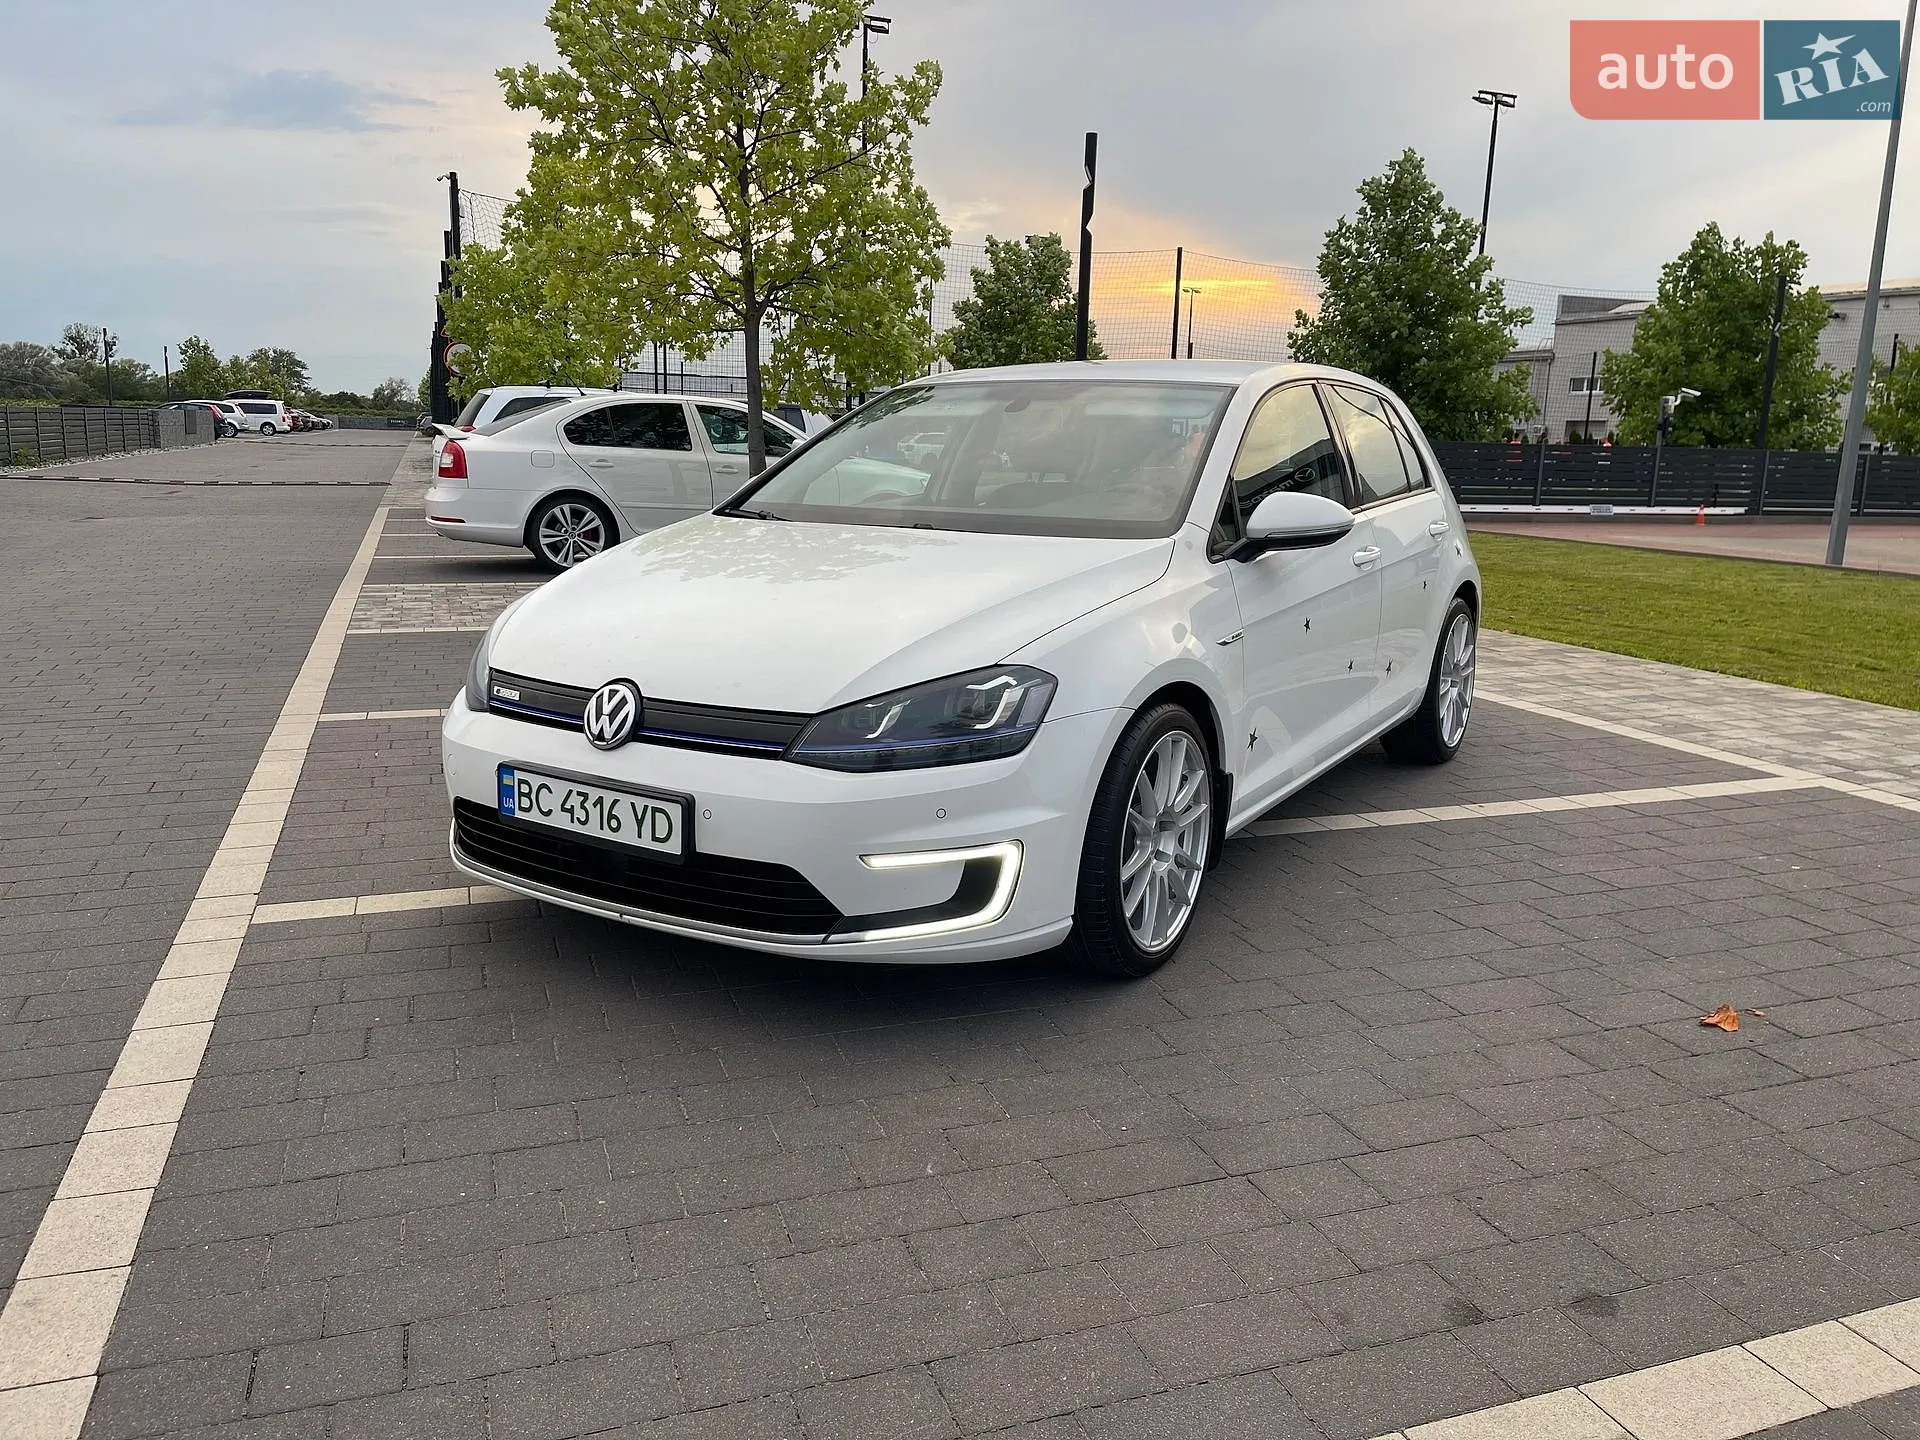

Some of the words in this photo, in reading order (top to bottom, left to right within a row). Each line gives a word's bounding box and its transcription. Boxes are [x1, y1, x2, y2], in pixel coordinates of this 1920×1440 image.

[503, 797, 514, 809] UA
[517, 777, 553, 817] BC
[560, 789, 622, 833] 4316
[630, 801, 673, 843] YD
